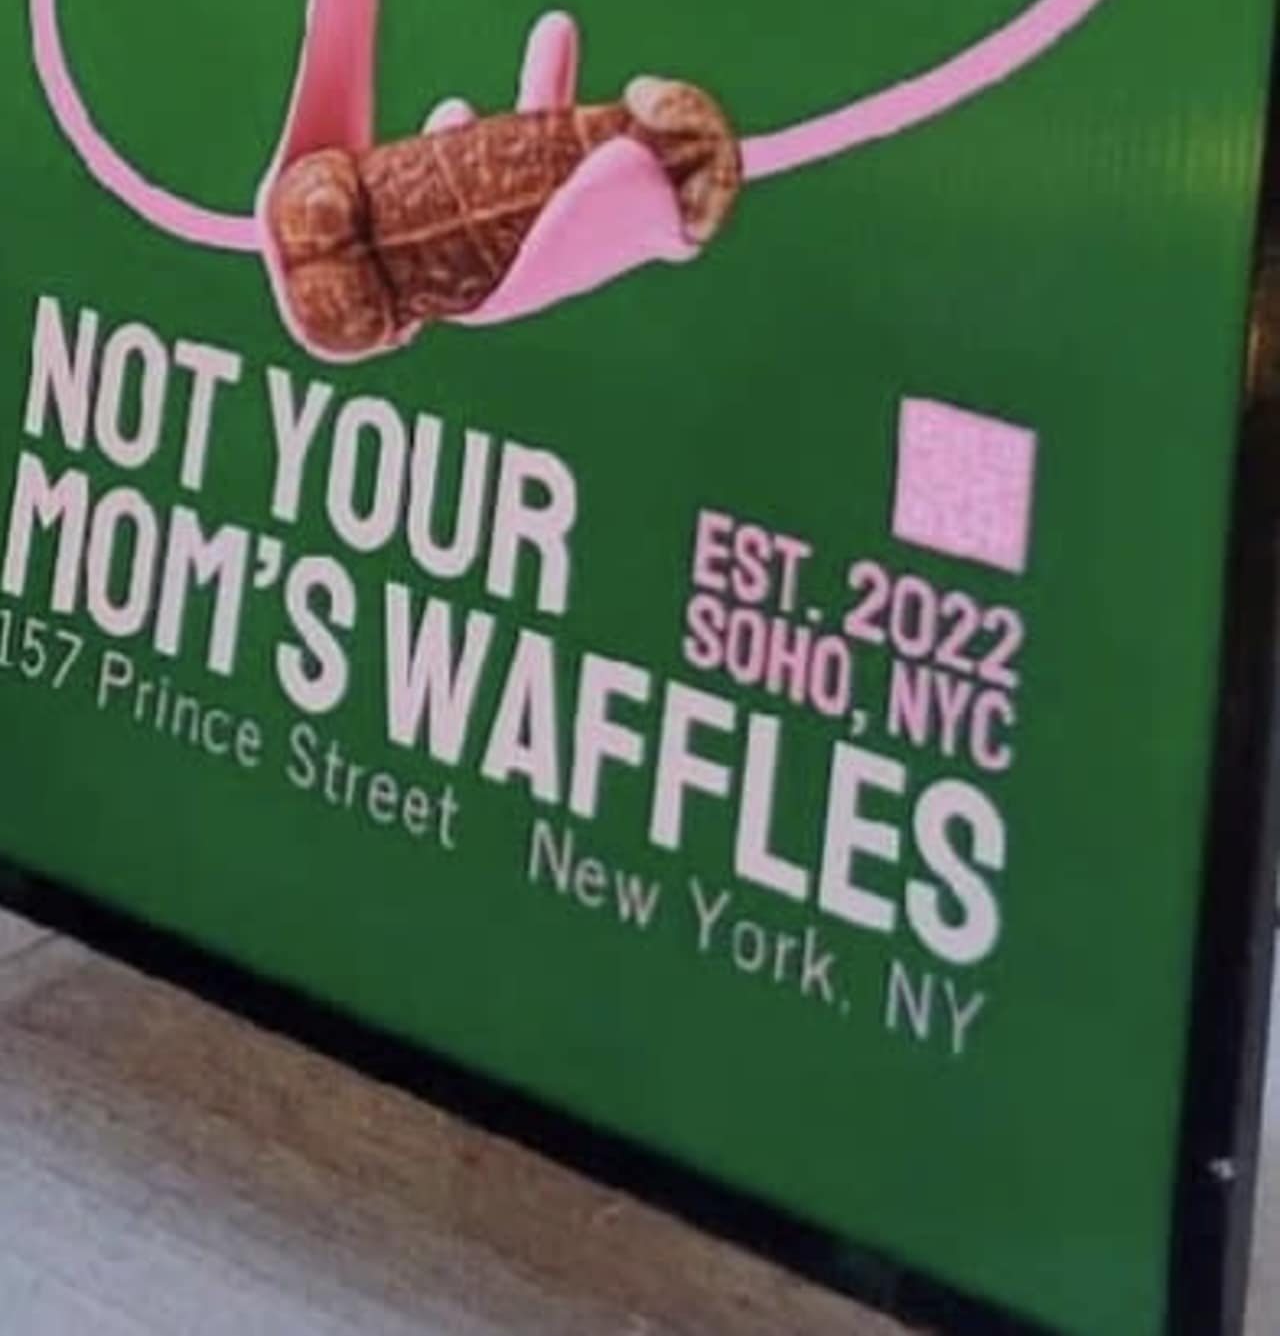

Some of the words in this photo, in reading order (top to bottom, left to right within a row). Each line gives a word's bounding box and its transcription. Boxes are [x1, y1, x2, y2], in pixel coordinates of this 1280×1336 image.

[24, 295, 242, 491] NOT
[266, 365, 578, 615] YOUR
[692, 509, 822, 623] EST.
[843, 560, 1025, 689] 2022
[0, 451, 356, 714] MOM'S
[383, 580, 1006, 965] WAFFLES
[683, 595, 867, 735] SOHO,
[888, 659, 1016, 772] NYC
[96, 650, 263, 768] Prince
[286, 723, 461, 849] Street
[529, 819, 660, 927] New
[885, 959, 985, 1057] NY
